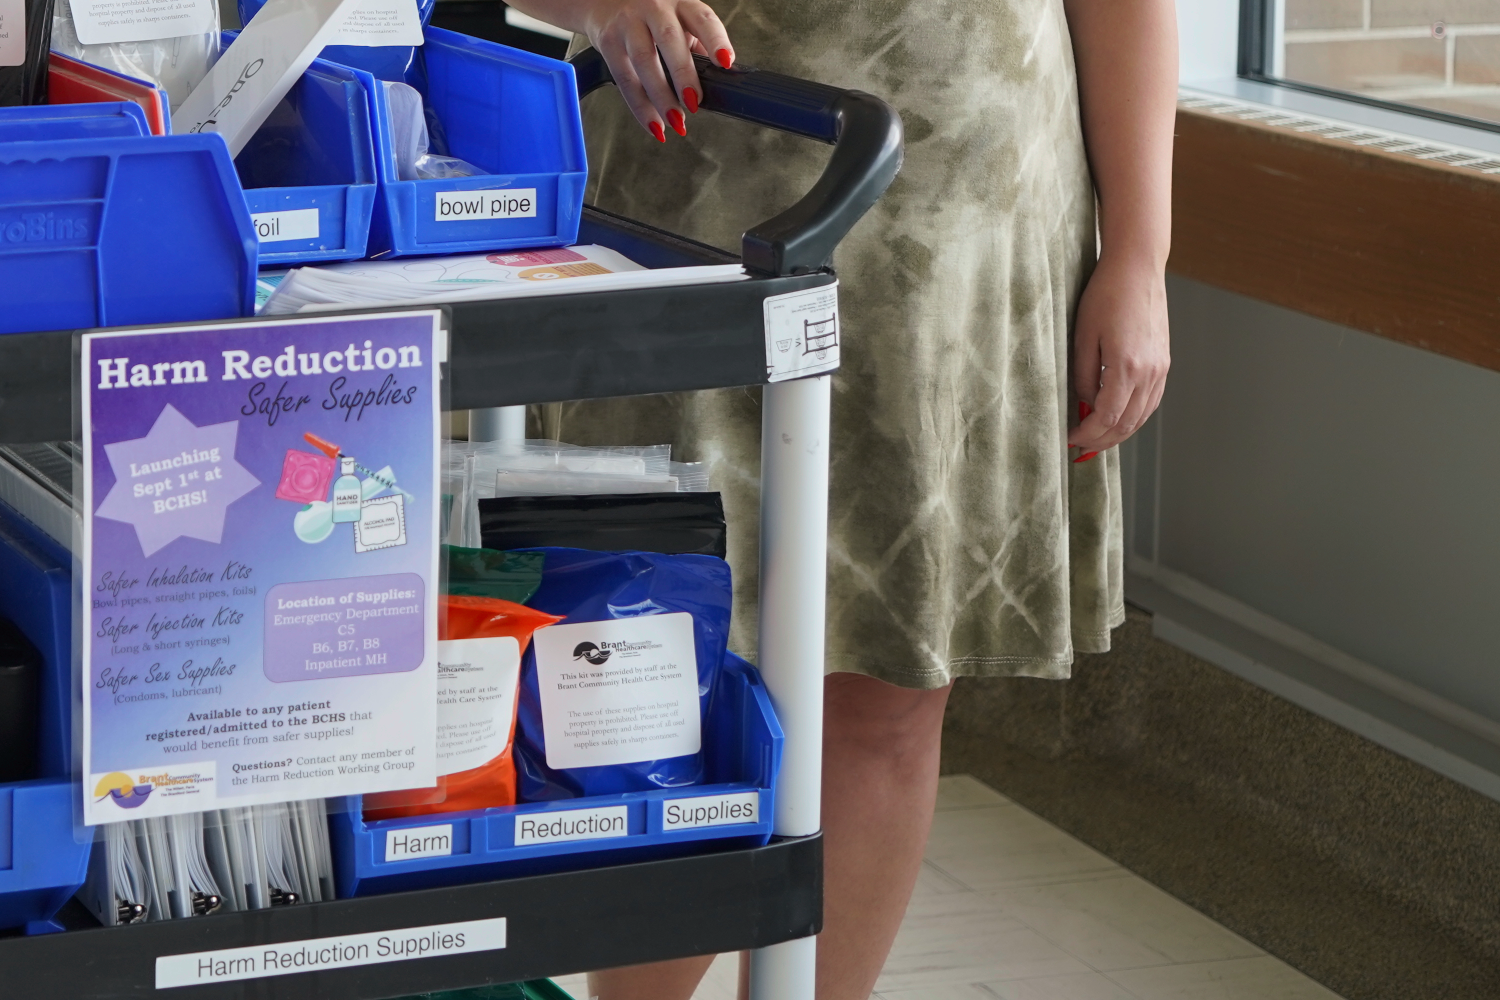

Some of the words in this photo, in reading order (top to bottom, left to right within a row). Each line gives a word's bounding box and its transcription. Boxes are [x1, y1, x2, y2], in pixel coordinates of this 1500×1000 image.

[440, 196, 484, 216] bowl
[490, 195, 531, 217] pipe
[97, 357, 209, 390] Harm
[221, 339, 423, 381] Reduction
[240, 381, 311, 427] Safer
[321, 373, 418, 423] Supplies
[129, 447, 221, 478] Launching
[133, 477, 173, 498] Sept
[178, 469, 199, 488] 1st
[204, 466, 223, 482] at
[153, 489, 208, 515] BCHS!
[96, 570, 139, 598] Safer
[146, 565, 214, 588] Inhalation
[220, 560, 253, 582] Kits
[121, 596, 151, 608] pipes,
[155, 592, 195, 605] straight
[199, 589, 229, 601] pipes,
[232, 586, 257, 597] foils)
[277, 596, 335, 610] Location
[339, 592, 355, 604] of
[356, 589, 415, 604] Supplies:
[96, 615, 139, 643] Safer
[145, 613, 205, 640] Injection
[212, 606, 244, 627] Kits
[274, 612, 342, 626] Emergency
[346, 604, 419, 620] Department
[337, 624, 355, 636] C5
[111, 644, 140, 656] (Long
[142, 642, 151, 651] &
[154, 639, 181, 651] short
[184, 635, 230, 648] syringes)
[312, 642, 334, 654] B6,
[338, 640, 359, 652] B7,
[363, 638, 380, 650] B8
[601, 640, 627, 650] Brant
[305, 656, 362, 672] Inpatient
[365, 653, 387, 666] MH
[605, 668, 634, 679] provided
[635, 667, 643, 675] by
[96, 667, 138, 695] Safer
[144, 663, 171, 684] Sex
[177, 657, 237, 687] Supplies
[578, 679, 620, 689] Community
[621, 676, 643, 684] Health
[660, 672, 682, 681] System
[113, 692, 169, 706] (Condoms,
[172, 685, 222, 698] lubricant)
[187, 707, 242, 722] Available
[246, 705, 258, 716] to
[262, 705, 284, 716] any
[288, 700, 332, 714] patient
[145, 720, 268, 742] registered/admitted
[271, 718, 284, 729] to
[288, 716, 307, 727] the
[311, 713, 346, 725] BCHS
[349, 710, 373, 721] that
[162, 741, 197, 754] would
[201, 737, 240, 750] benefit
[243, 734, 268, 746] from
[273, 731, 300, 743] safer
[303, 726, 354, 741] supplies!
[232, 758, 293, 774] Questions?
[296, 755, 337, 766] Contact
[339, 754, 358, 764] any
[361, 749, 402, 760] member
[404, 746, 416, 756] of
[138, 772, 169, 784] Brant
[155, 778, 194, 787] Healthcare
[168, 773, 201, 781] Community
[232, 776, 248, 786] the
[251, 773, 280, 784] Harm
[283, 768, 334, 781] Reduction
[337, 763, 380, 775] Working
[382, 761, 415, 772] Group
[392, 833, 449, 855] Harm
[521, 813, 624, 840] Reduction
[666, 800, 754, 825] Supplies
[198, 954, 255, 978] Harm
[263, 942, 369, 970] Reduction
[376, 931, 466, 958] Supplies
